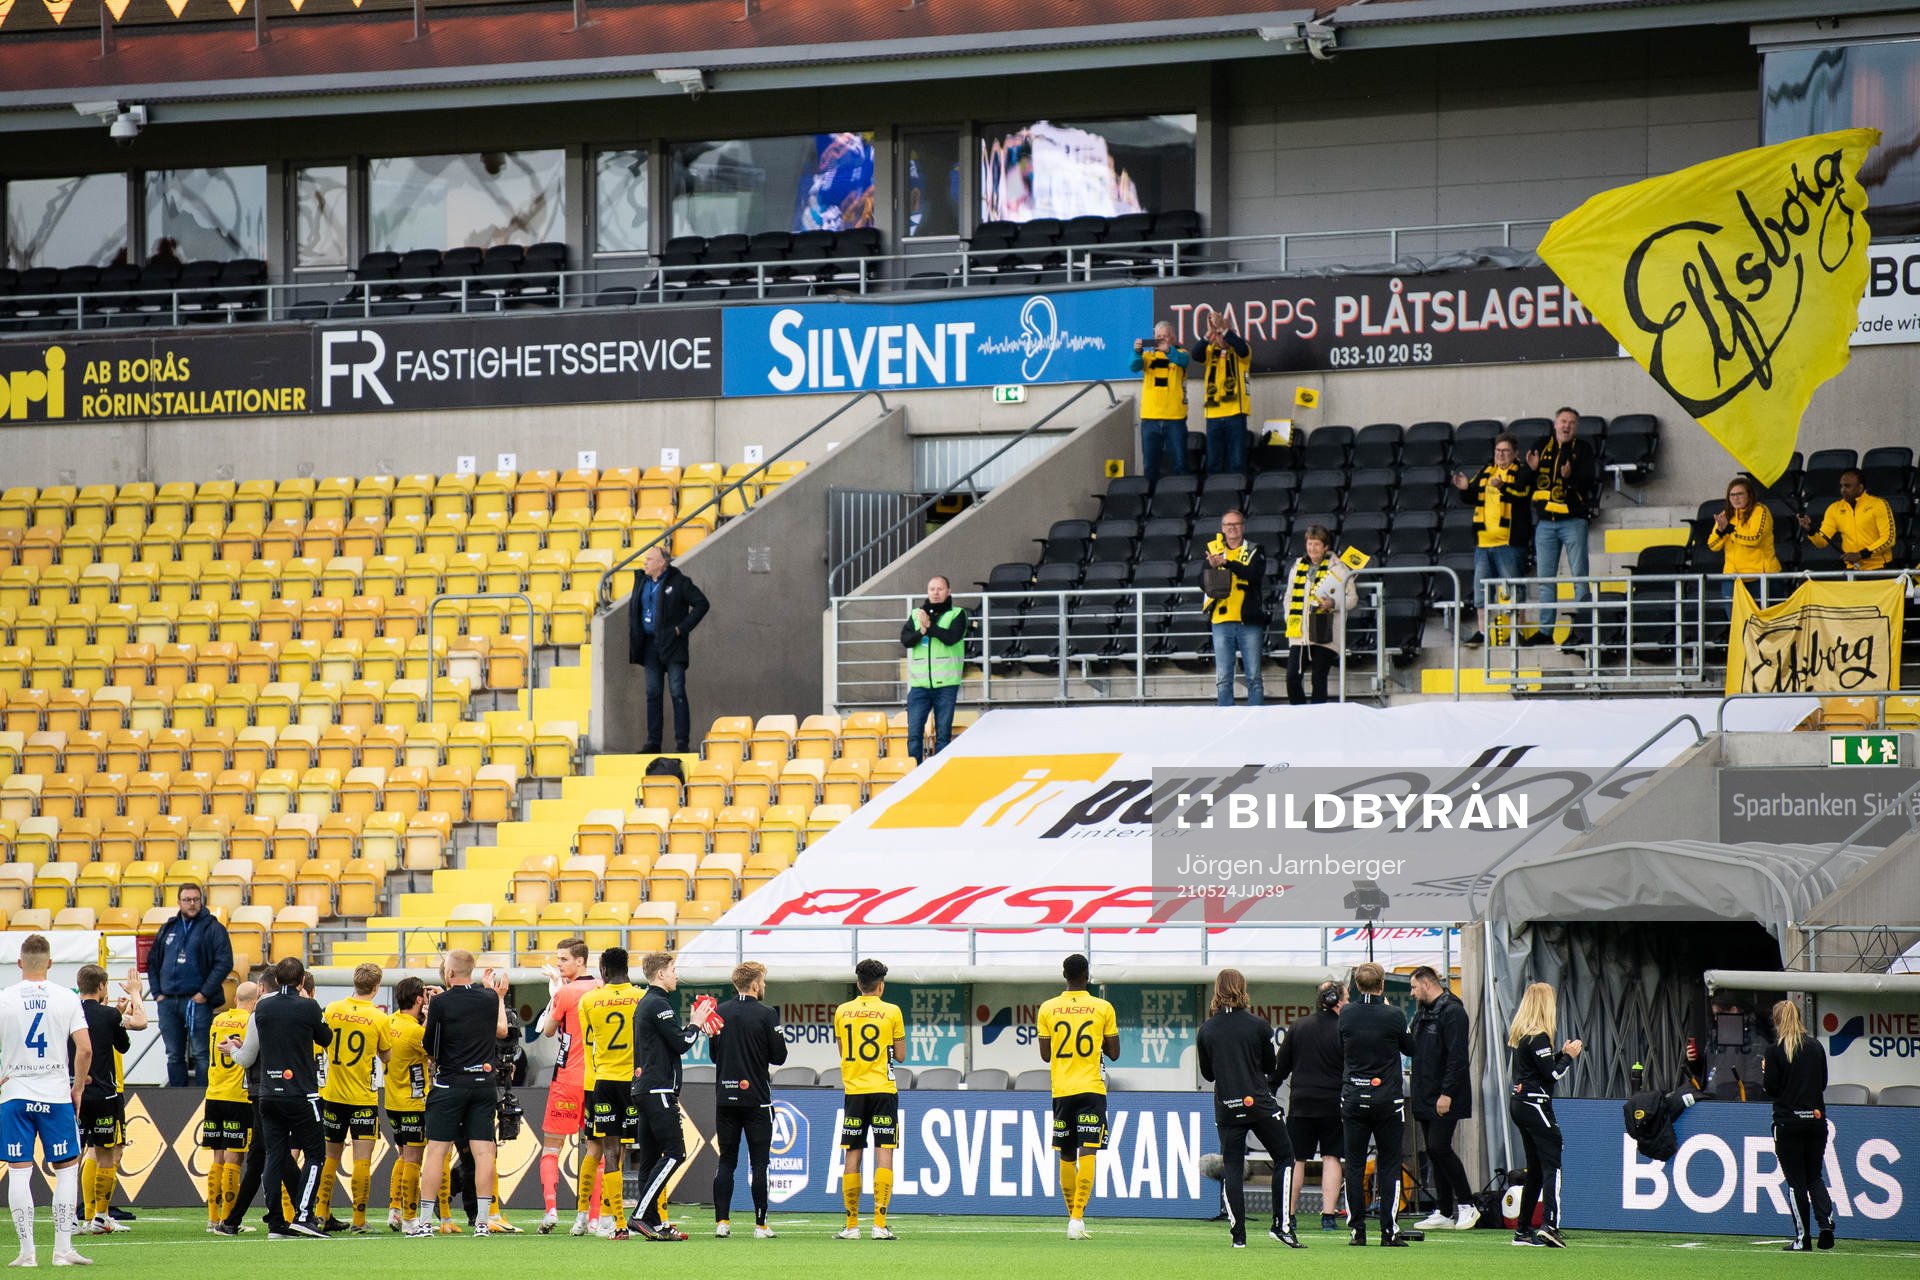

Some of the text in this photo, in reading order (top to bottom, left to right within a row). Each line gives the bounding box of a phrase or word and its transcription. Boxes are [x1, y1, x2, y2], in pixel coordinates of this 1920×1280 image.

[1335, 278, 1600, 337] PLÅTSLAGER
[767, 309, 975, 391] SILVENT
[1330, 343, 1433, 366] 033-10 20 53
[83, 351, 190, 385] AB BORÅS
[322, 330, 712, 407] FR FASTIGHETSSERVICE
[0, 346, 66, 420] ri
[82, 387, 306, 418] RÖRINSTALLATIONER
[1733, 793, 1857, 822] Sparbanken
[24, 1000, 47, 1011] LUND
[911, 989, 956, 1013] EFF
[1052, 1006, 1096, 1016] PULSEN
[1141, 989, 1188, 1014] EFF
[331, 1012, 373, 1027] PULSEN
[842, 1010, 886, 1020] PULSEN
[911, 1013, 961, 1038] EKT
[1141, 1014, 1193, 1039] EKT
[24, 1012, 48, 1059] 4
[605, 1011, 628, 1051] 2
[845, 1023, 881, 1062] 18
[1053, 1020, 1095, 1059] 26
[331, 1027, 366, 1067] 19
[26, 1102, 51, 1114] RÖR
[1080, 1115, 1098, 1124] EAB
[7, 1142, 23, 1157] nt
[53, 1140, 68, 1156] nt
[826, 1107, 1201, 1199] ALSVENKAN
[768, 1180, 793, 1189] NIBET
